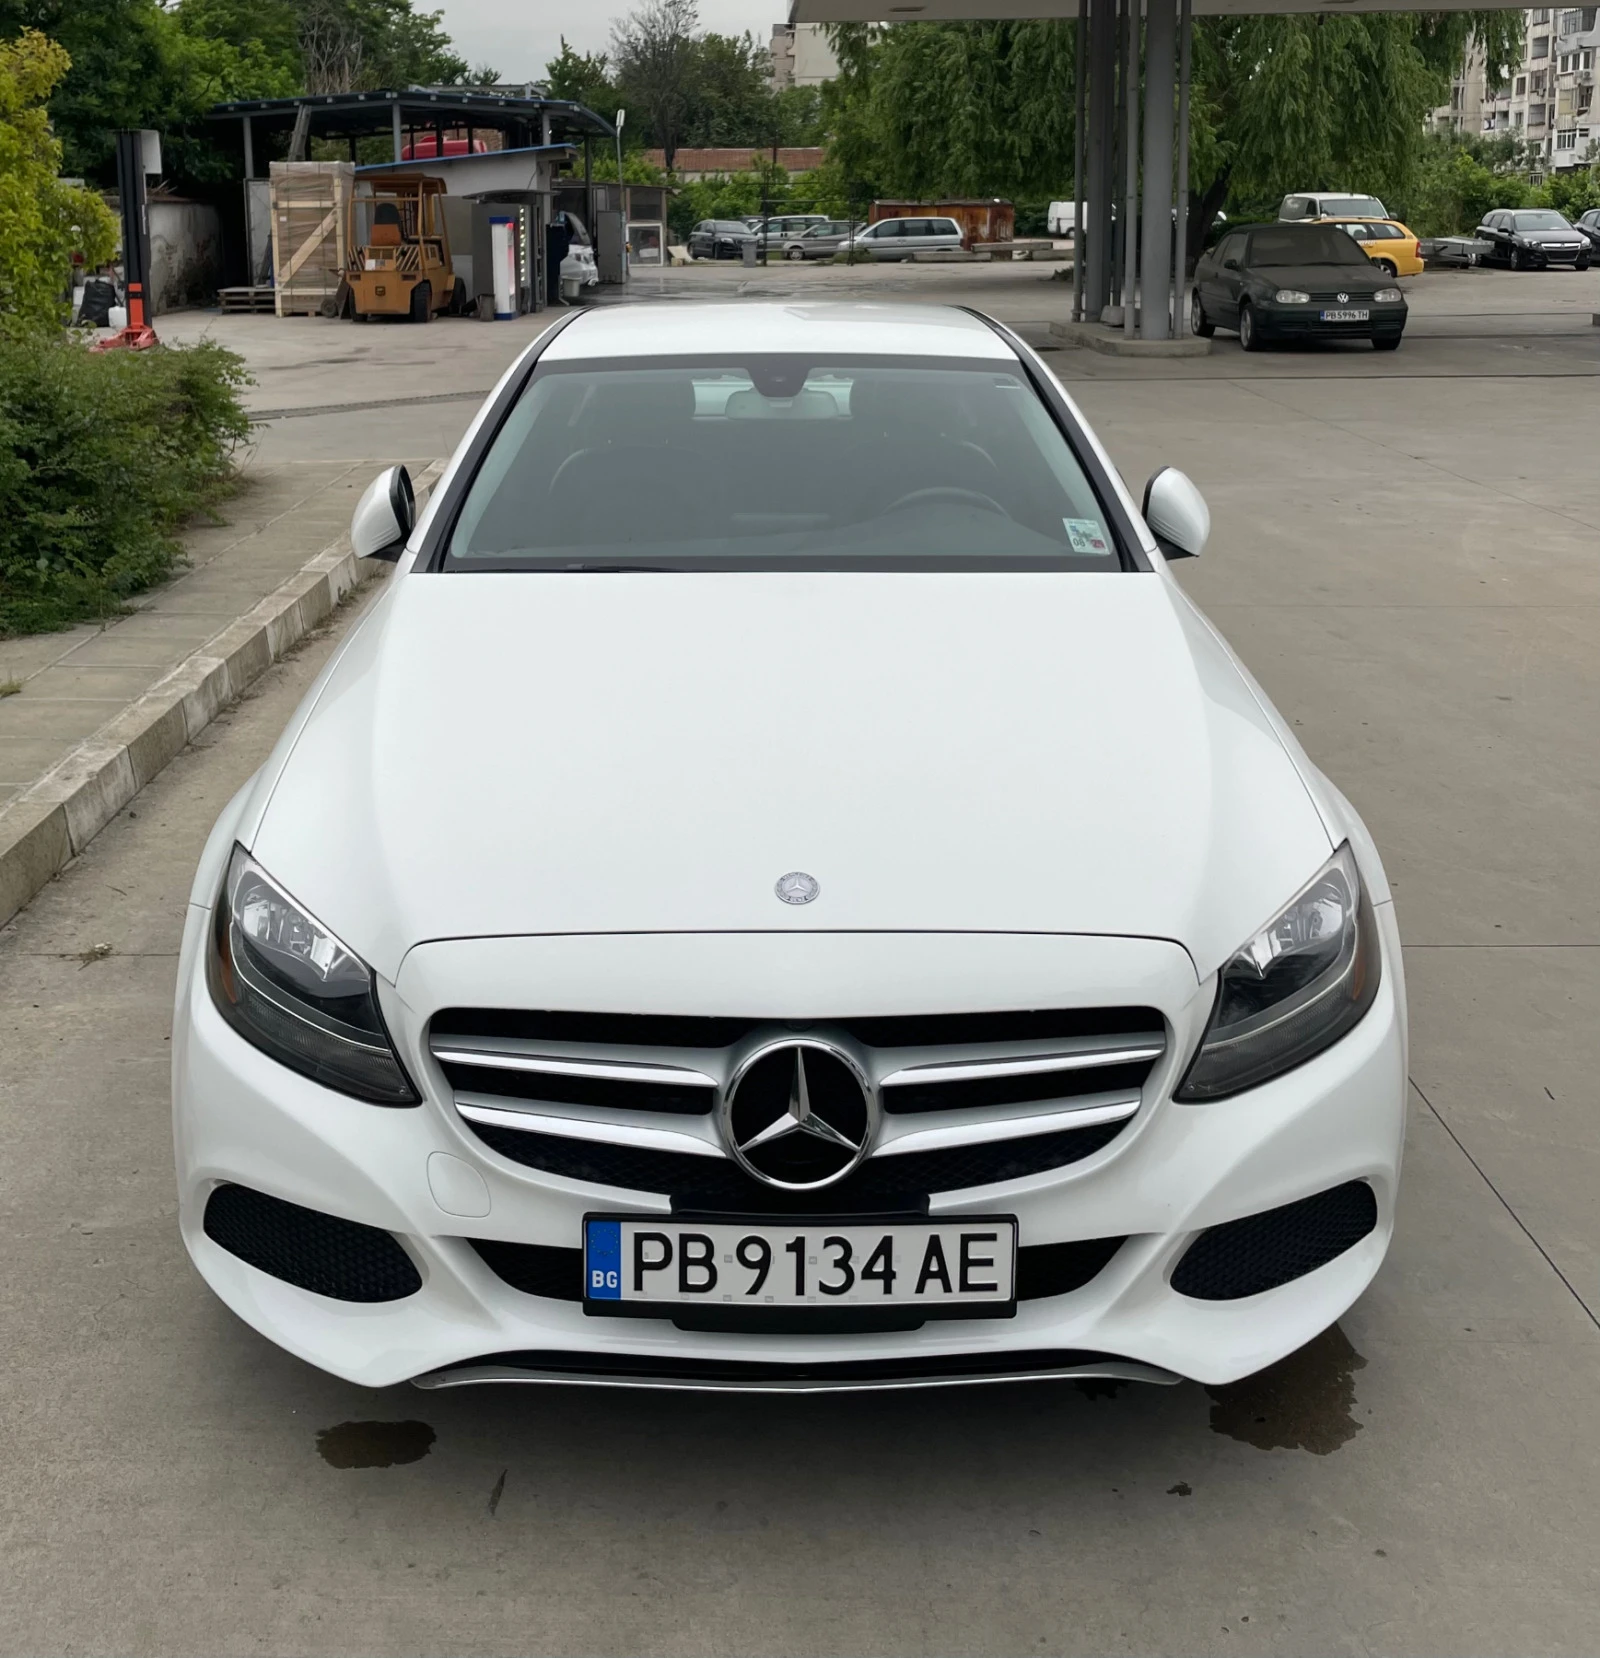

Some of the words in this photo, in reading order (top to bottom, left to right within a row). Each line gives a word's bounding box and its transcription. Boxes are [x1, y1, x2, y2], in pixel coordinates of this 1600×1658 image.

[1325, 311, 1336, 319] PB
[1337, 311, 1356, 319] 5996
[1357, 311, 1368, 319] TH
[634, 1233, 717, 1293] PB
[736, 1236, 896, 1296] 9134
[915, 1233, 997, 1293] AE
[592, 1271, 617, 1288] BG
